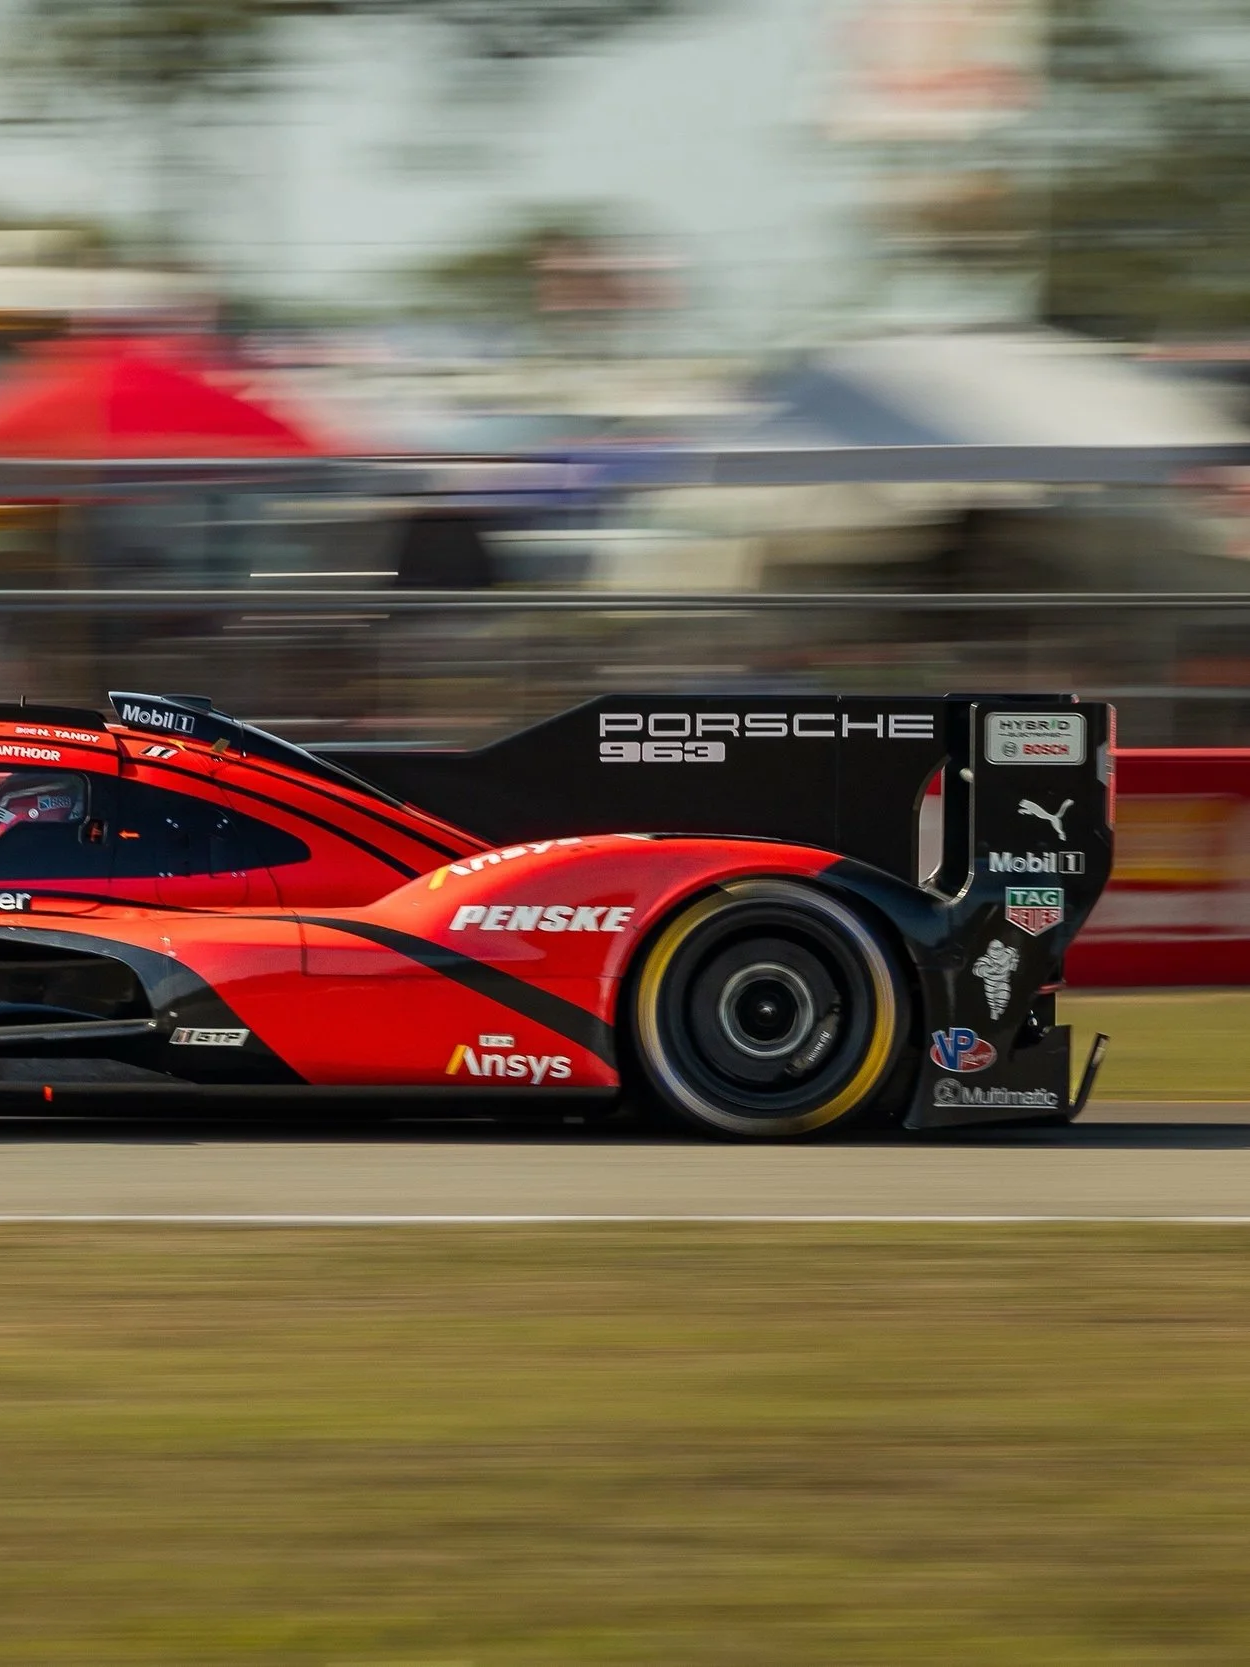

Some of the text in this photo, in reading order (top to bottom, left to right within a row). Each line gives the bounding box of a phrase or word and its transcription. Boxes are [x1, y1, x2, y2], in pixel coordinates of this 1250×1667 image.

[122, 703, 174, 729] Mobil
[599, 713, 934, 739] PORSCHE
[999, 720, 1070, 730] HYBRID
[37, 728, 100, 743] N. TANDY
[599, 742, 726, 762] 963
[1023, 743, 1069, 755] BOSCH
[427, 837, 583, 890] Ansys
[989, 852, 1057, 873] Mobil
[1011, 890, 1059, 906] TAG
[449, 905, 635, 932] PENSKE
[195, 1031, 242, 1043] GTP
[932, 1027, 979, 1070] VP
[445, 1044, 572, 1085] Ansys
[962, 1086, 1059, 1106] Multimatic
